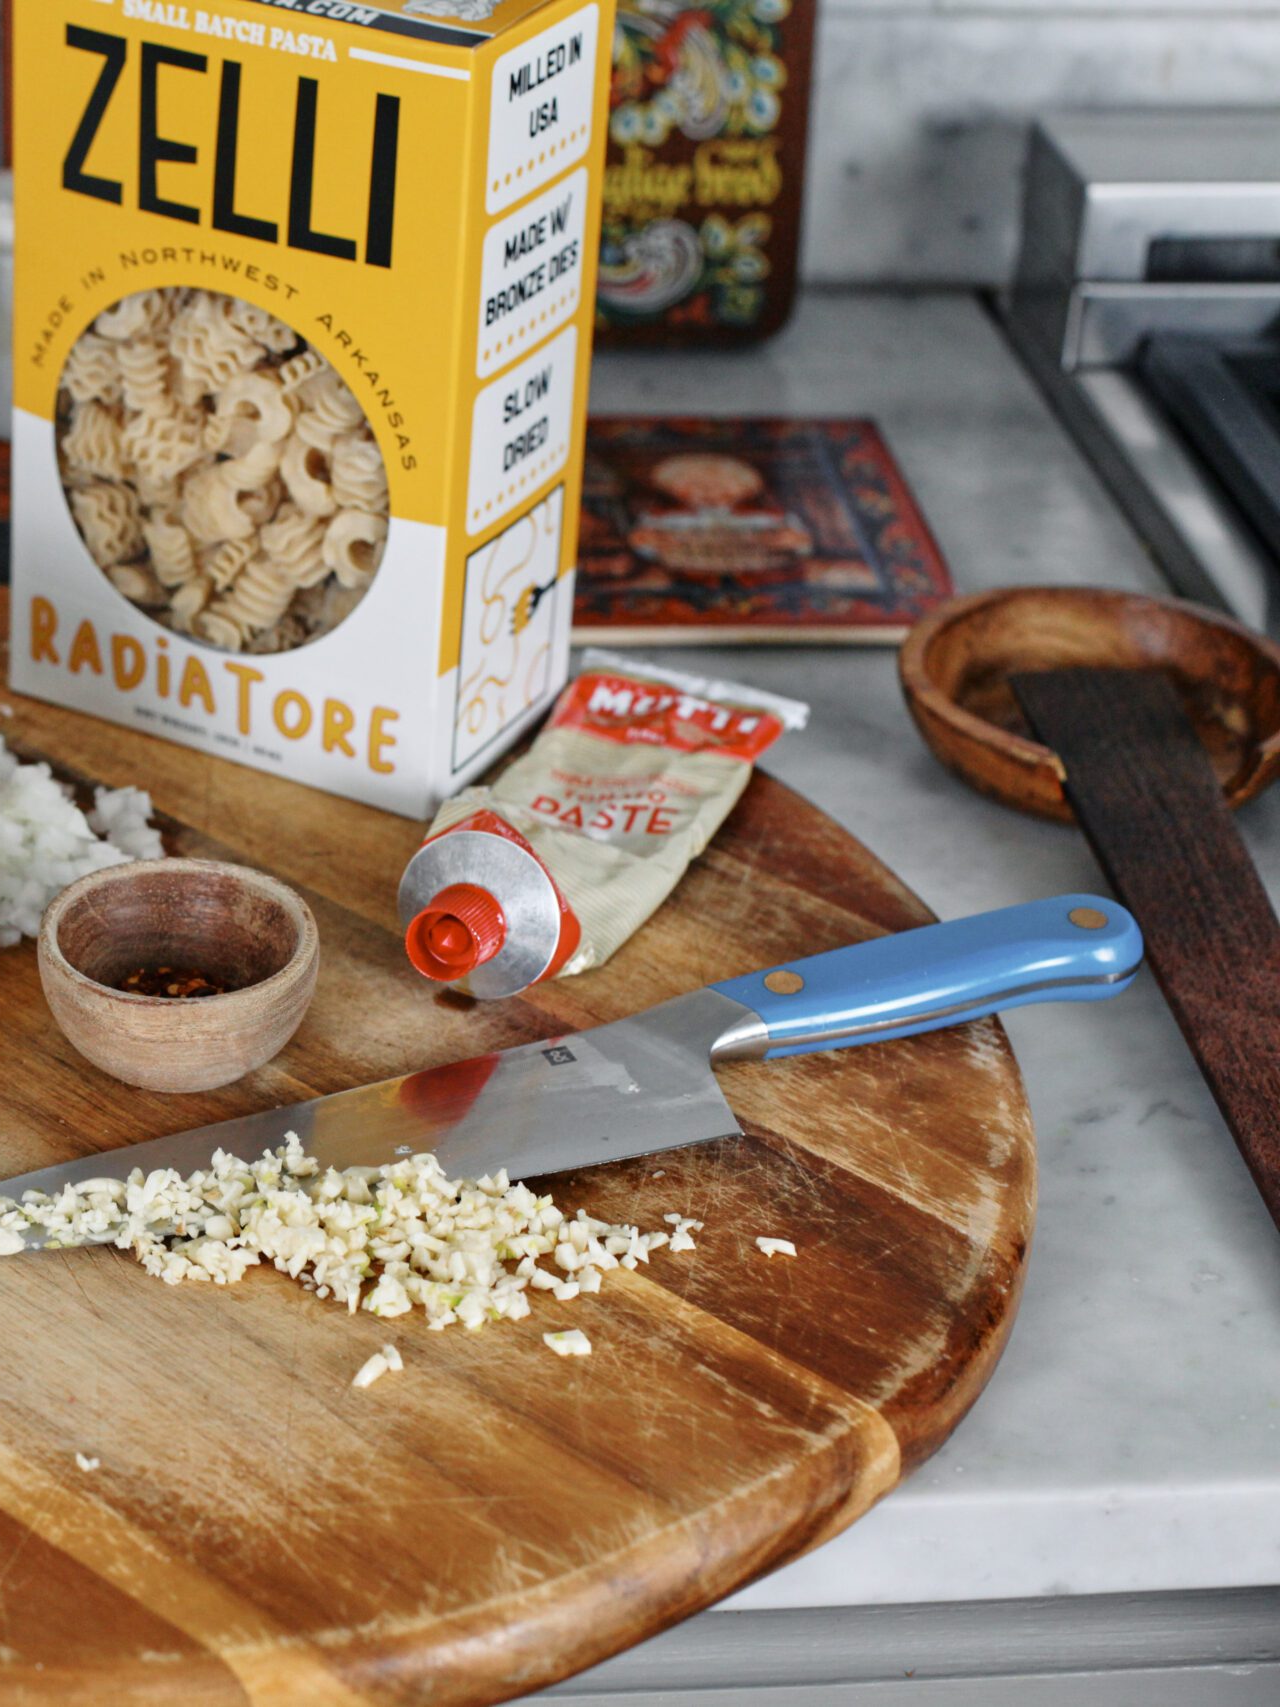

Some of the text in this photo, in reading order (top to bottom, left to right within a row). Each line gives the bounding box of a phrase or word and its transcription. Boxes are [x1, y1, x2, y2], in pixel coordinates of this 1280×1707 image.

[122, 0, 338, 63] SMALL BATCH PASTA
[509, 31, 583, 103] MILLED IN
[62, 22, 401, 270] ZELLI
[529, 96, 558, 139] USA
[504, 191, 573, 269] MADE W/
[485, 239, 578, 327] BRONZE DIES
[30, 246, 418, 472] MADE IN NORTHWEST ARKANSAS
[503, 362, 553, 425] SLOW
[503, 415, 549, 474] DRIED
